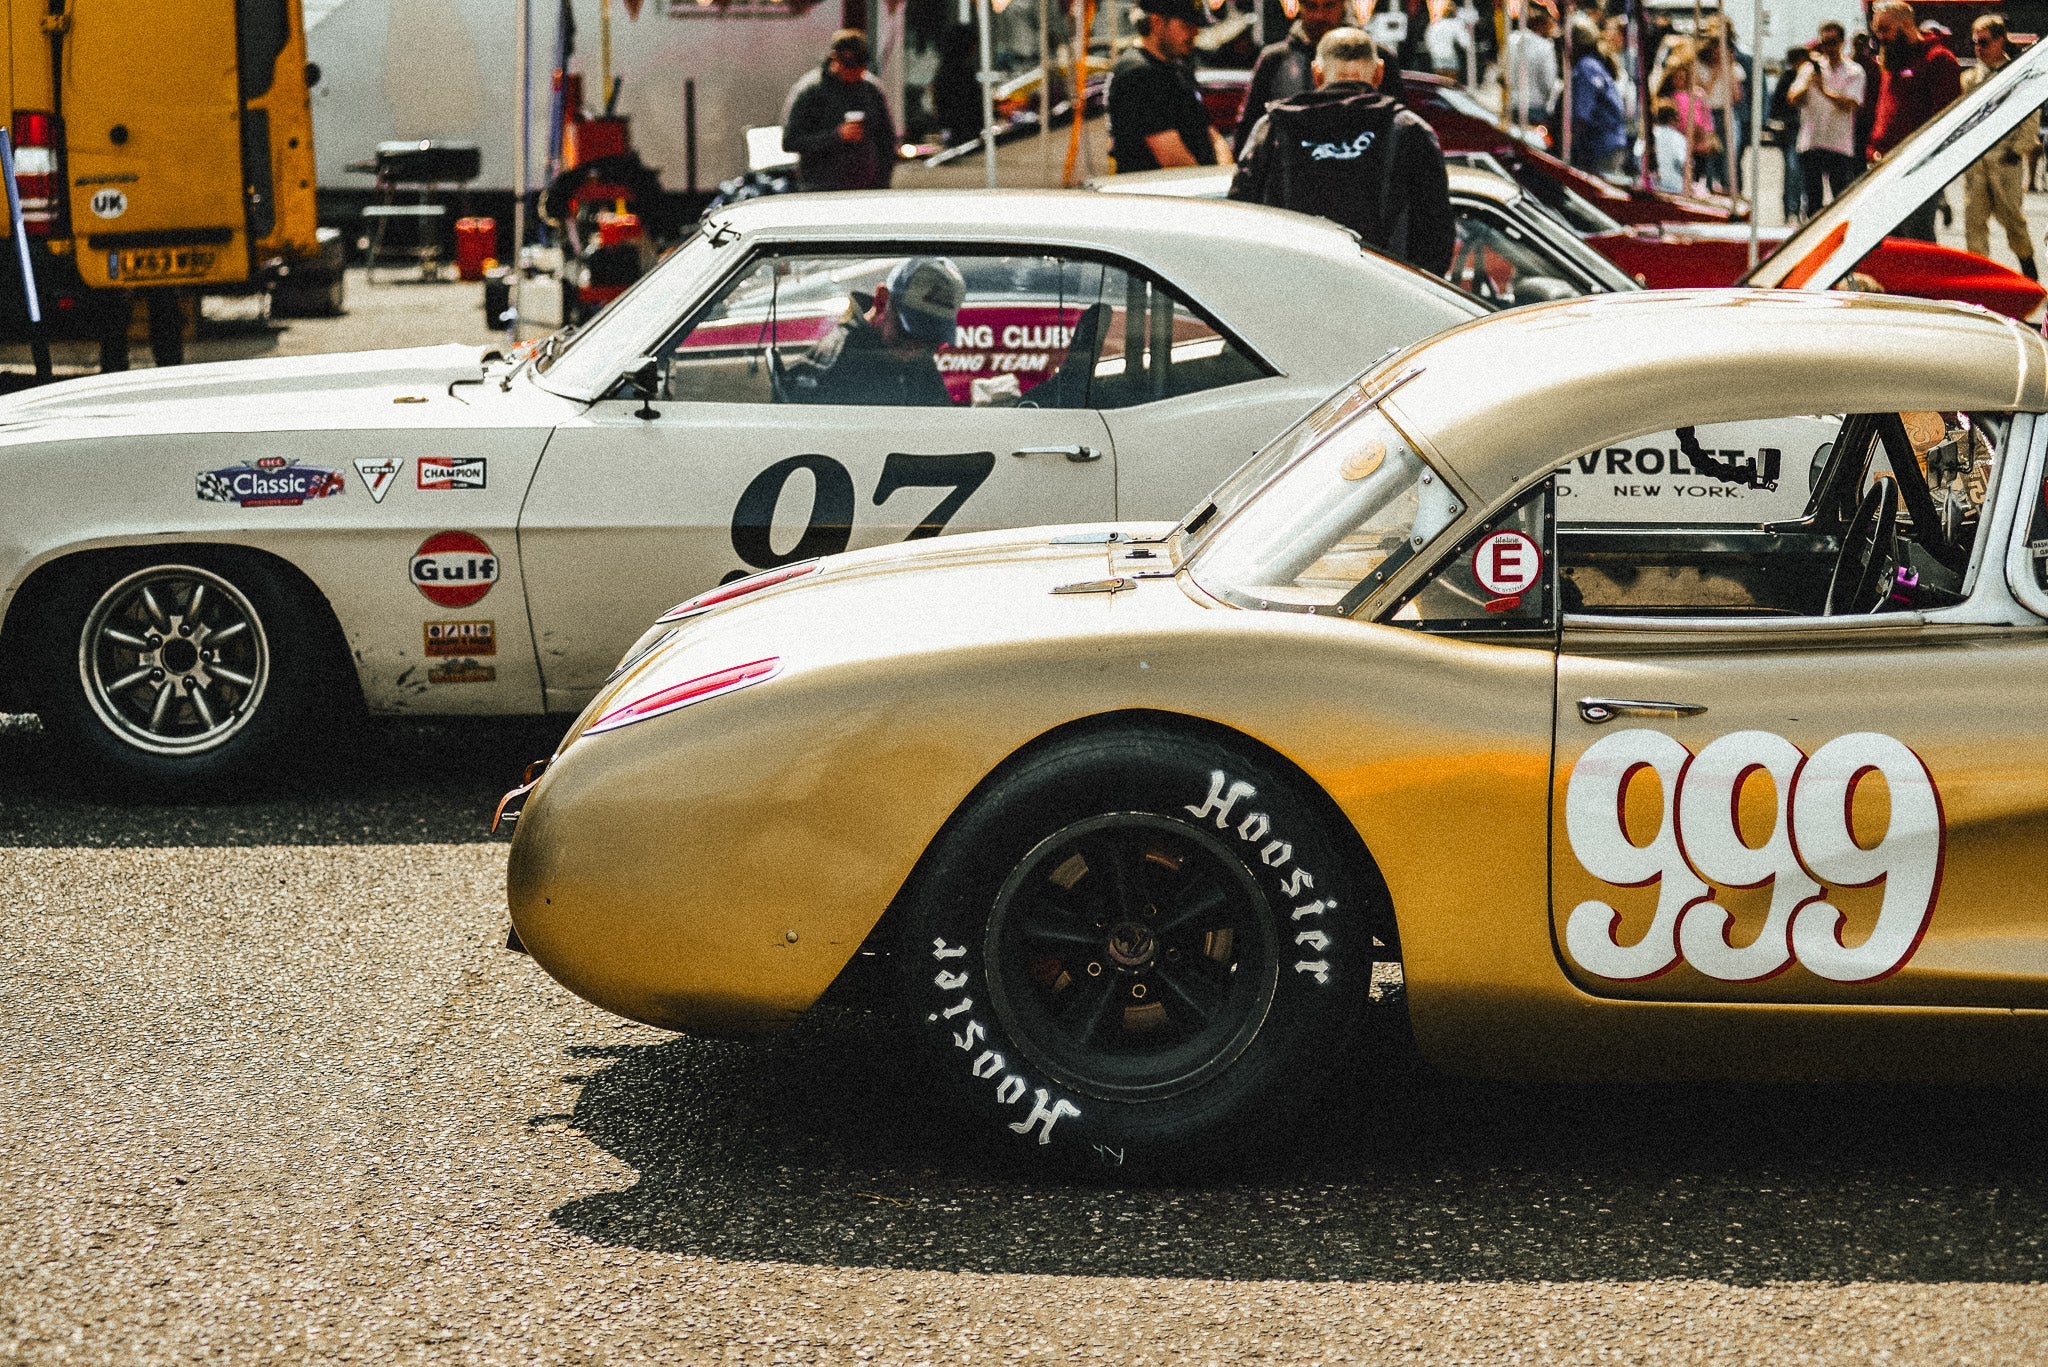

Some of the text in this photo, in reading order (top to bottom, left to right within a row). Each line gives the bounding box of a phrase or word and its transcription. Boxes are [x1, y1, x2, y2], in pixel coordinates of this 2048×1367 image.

[93, 194, 123, 212] UK
[1002, 325, 1076, 349] CLUB
[934, 353, 1050, 372] CING TEAM
[233, 473, 306, 495] Classic
[424, 468, 480, 479] CHAMPION
[1614, 485, 1661, 497] NEW
[1673, 485, 1745, 499] YORK.
[414, 559, 494, 581] Gulf
[1493, 544, 1523, 583] E
[1566, 728, 1948, 985] 999
[1184, 769, 1338, 985] Hoosier
[927, 937, 1082, 1145] Hoosier
